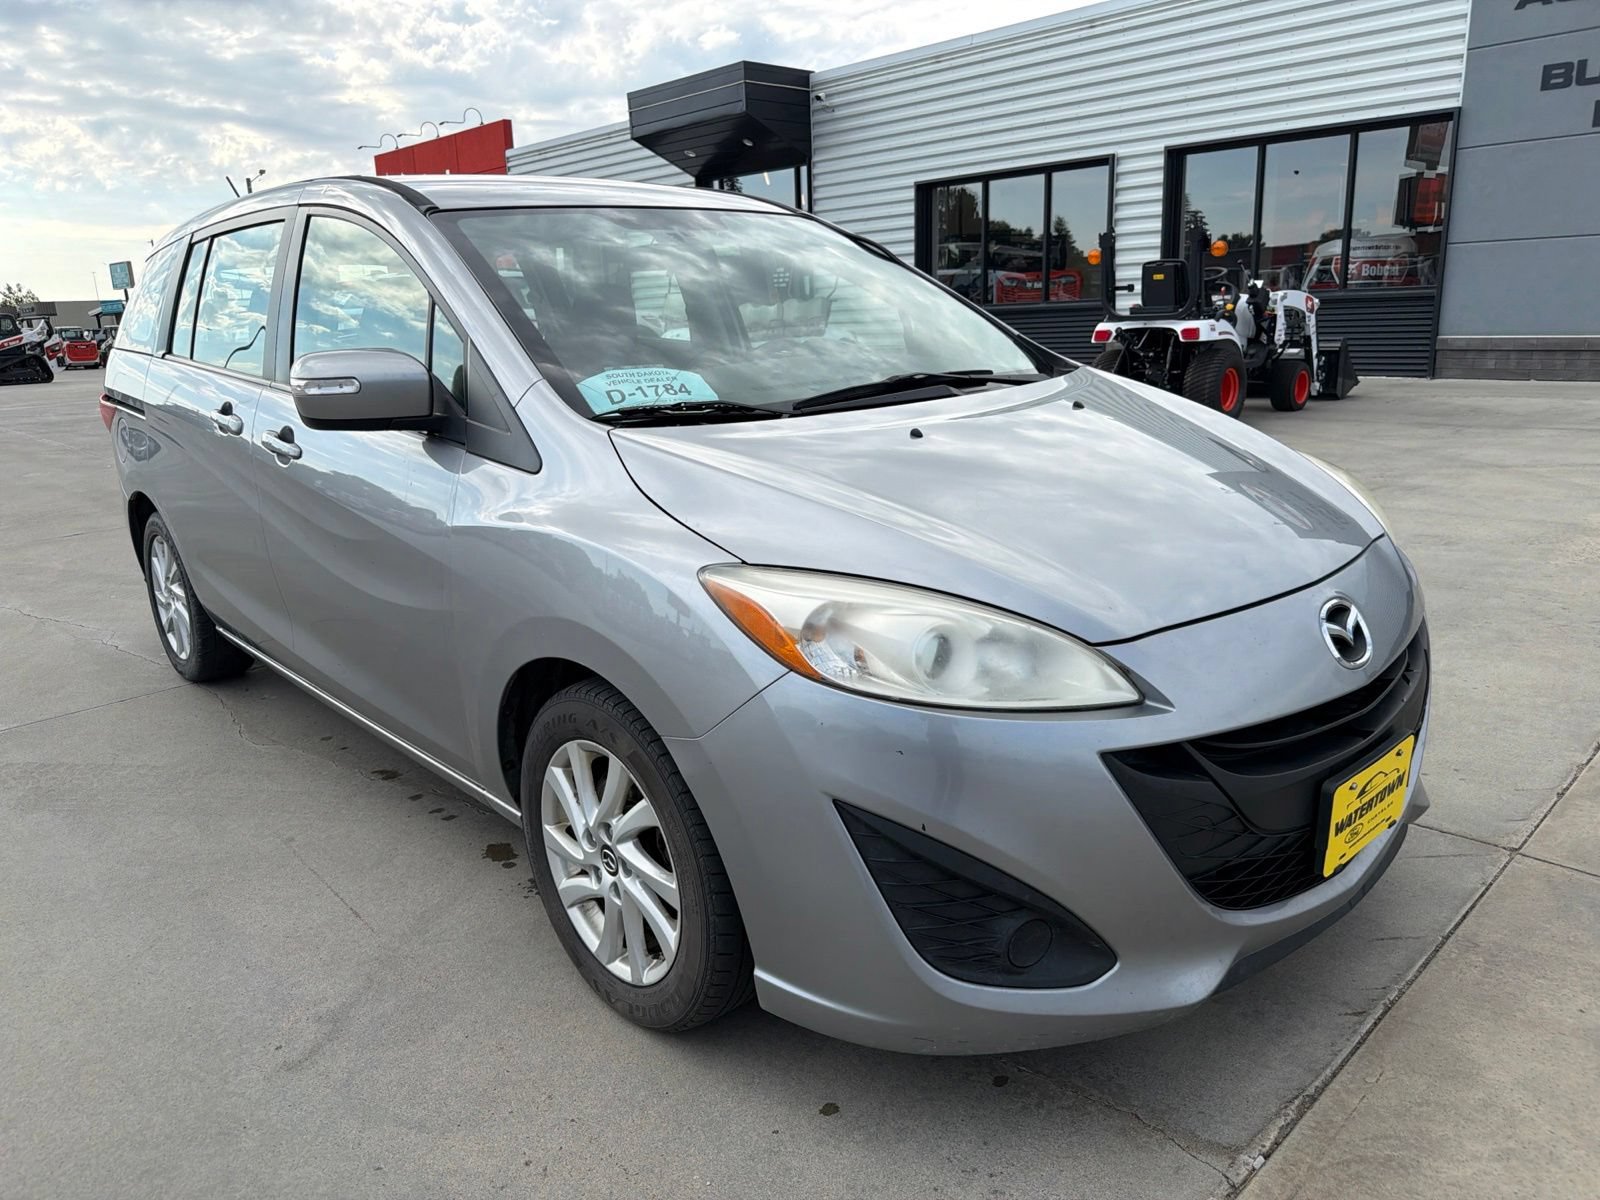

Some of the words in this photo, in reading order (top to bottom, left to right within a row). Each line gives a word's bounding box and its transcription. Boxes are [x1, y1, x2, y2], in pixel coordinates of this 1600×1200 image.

[605, 372, 636, 380] SOUTH
[637, 370, 671, 378] DAKOTA
[605, 377, 642, 387] VEHICLE
[644, 376, 678, 384] DEALER
[605, 383, 692, 405] D-1784
[1335, 770, 1406, 838] WATERTOWN
